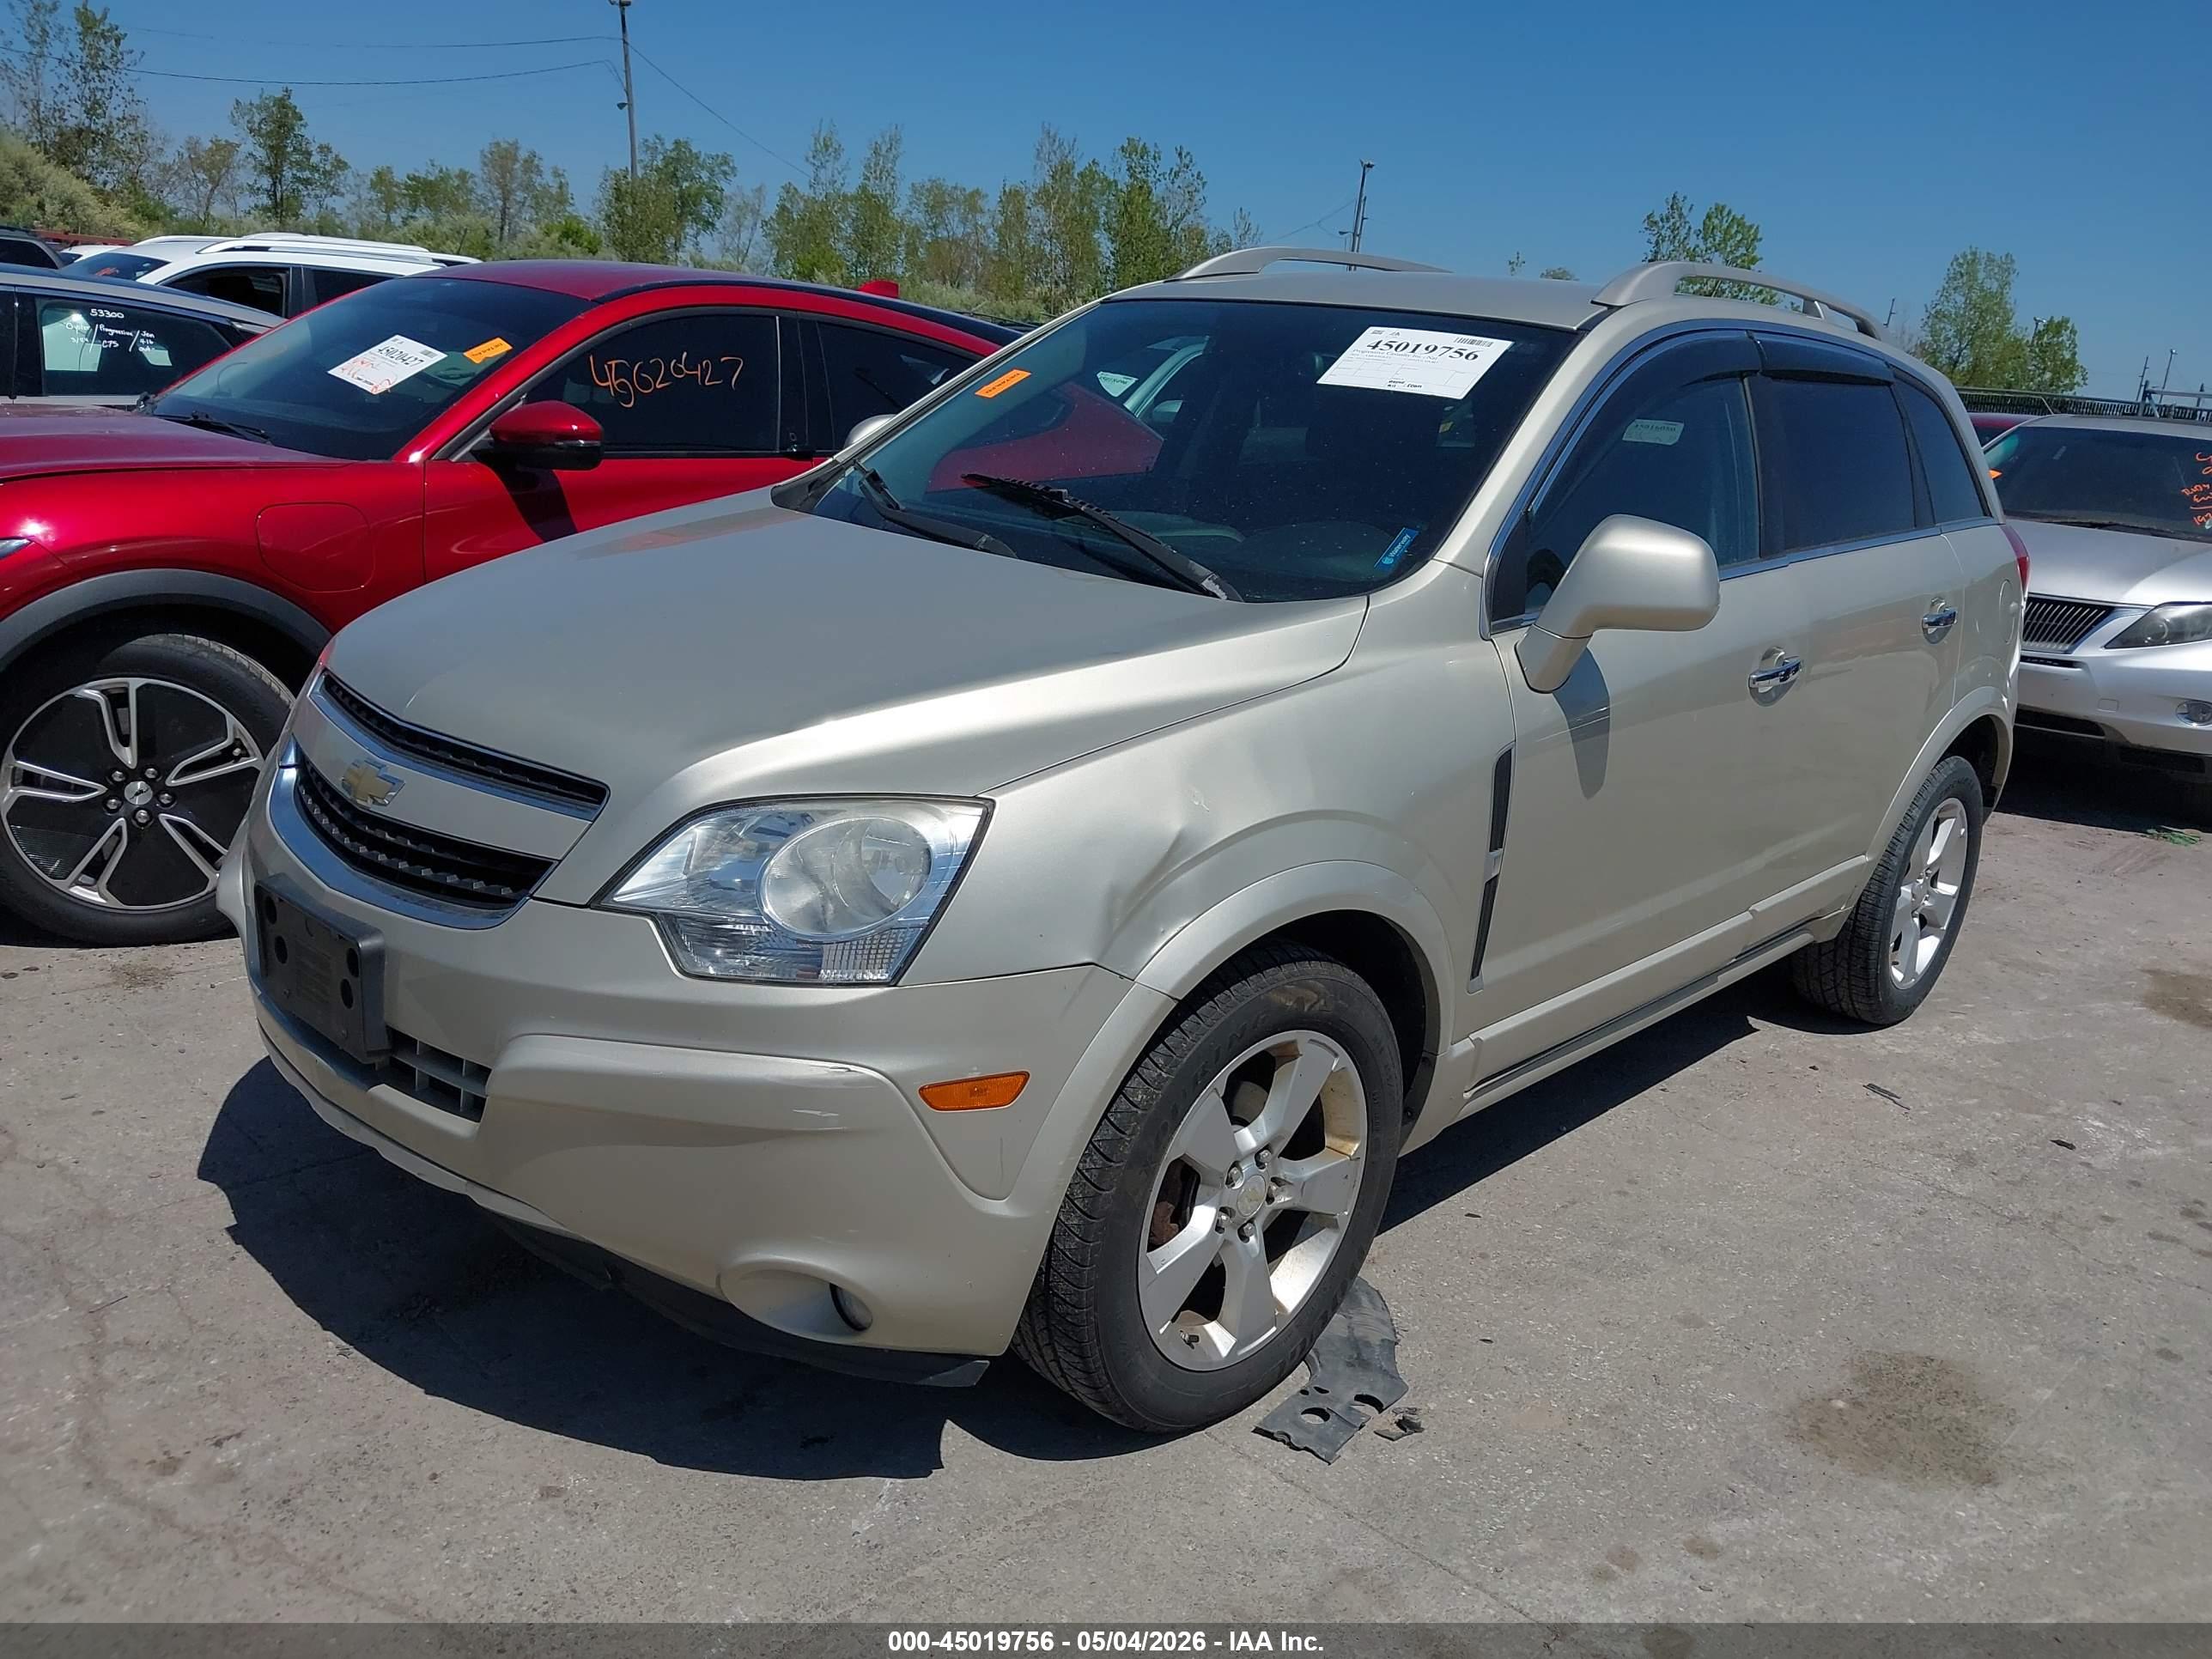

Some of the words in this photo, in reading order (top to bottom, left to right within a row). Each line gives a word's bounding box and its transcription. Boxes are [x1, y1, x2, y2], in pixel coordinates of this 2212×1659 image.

[90, 309, 125, 319] 53300
[378, 345, 425, 368] 45020427
[1367, 339, 1483, 362] 45019756
